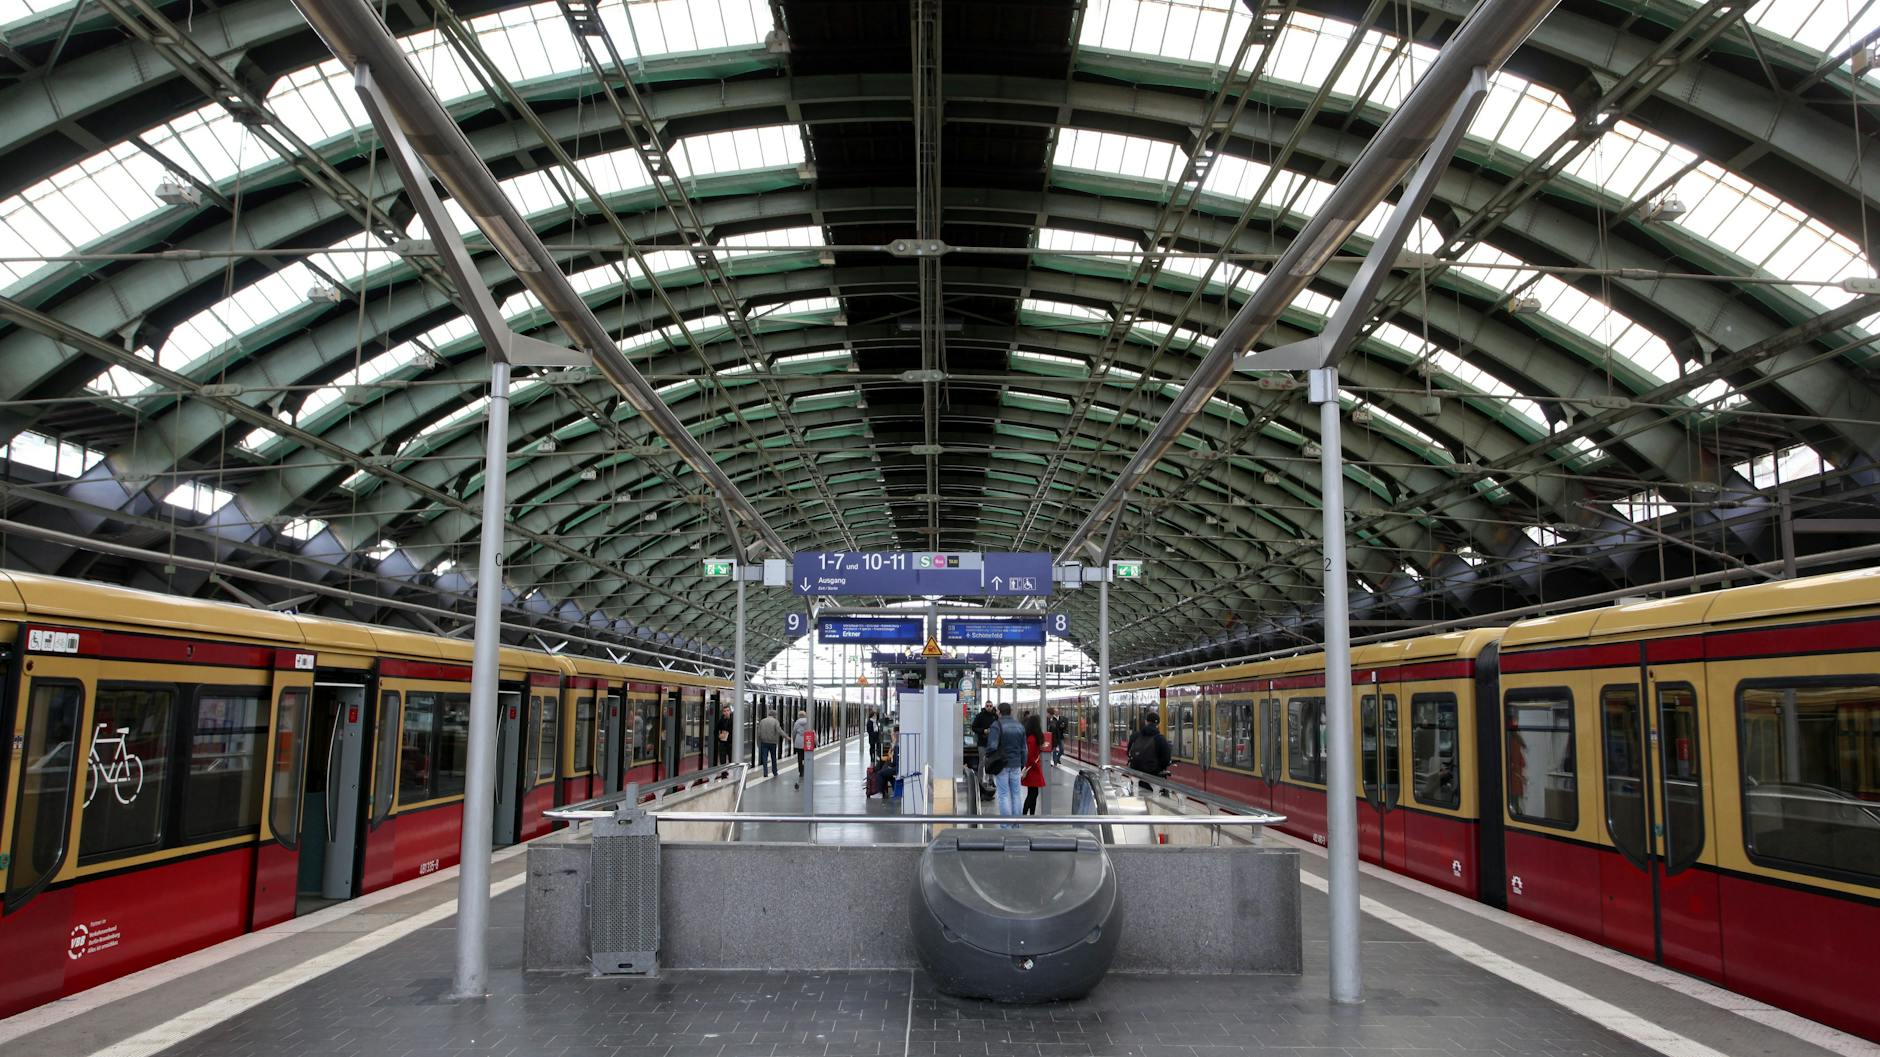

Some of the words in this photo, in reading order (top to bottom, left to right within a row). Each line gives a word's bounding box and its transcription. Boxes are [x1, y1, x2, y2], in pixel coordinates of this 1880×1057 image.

[818, 552, 845, 570] 1-7
[862, 553, 905, 570] 10-11
[920, 555, 930, 567] S
[1324, 557, 1332, 572] 2
[818, 576, 846, 585] Ausgang
[787, 613, 800, 631] 9
[1055, 614, 1067, 631] 8
[842, 630, 861, 638] Erkner
[71, 935, 87, 949] VBB
